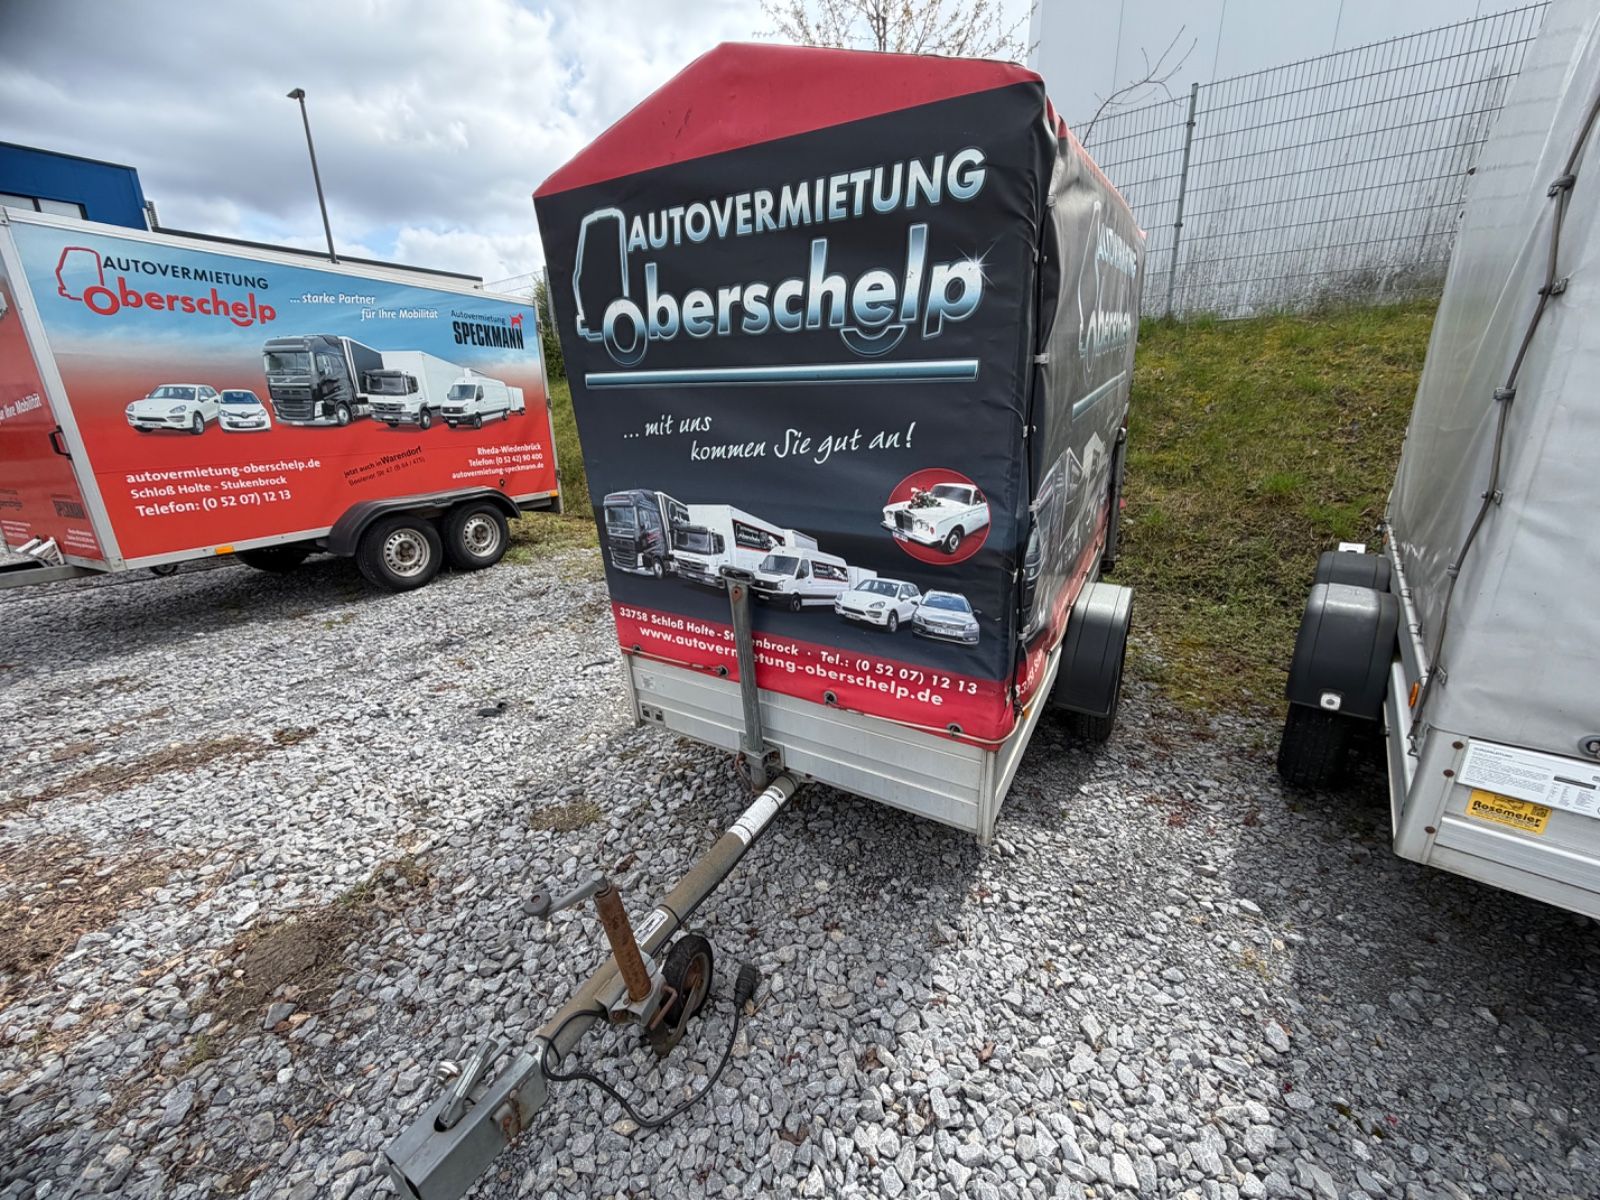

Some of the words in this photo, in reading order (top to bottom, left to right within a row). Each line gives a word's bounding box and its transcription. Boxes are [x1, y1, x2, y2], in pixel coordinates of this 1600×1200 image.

[627, 147, 987, 252] AUTOVERMIETUNG
[103, 255, 269, 289] AUTOVERMIETUNG
[83, 276, 276, 326] Oberschelp
[302, 293, 335, 304] starke
[338, 294, 376, 305] Partner
[603, 224, 984, 364] Oberschelp
[361, 308, 375, 322] für
[378, 308, 396, 319] Ihre
[400, 308, 438, 319] Mobilität
[451, 310, 506, 325] Autovermietung
[452, 320, 524, 350] SPECKMANN
[645, 414, 672, 436] mit
[679, 415, 712, 434] uns
[380, 445, 422, 465] Warendorf
[477, 443, 541, 455] Rheda-Wiedenbrück
[690, 440, 766, 461] kommen
[774, 428, 810, 458] Sie
[814, 428, 862, 464] gut
[868, 422, 916, 450] an!
[125, 458, 321, 484] autovermietung-oberschelp.de
[452, 462, 544, 479] autovermietung-speckmann.de
[468, 458, 495, 467] Telefon:
[130, 486, 176, 499] Schloß
[178, 483, 212, 495] Holte
[220, 475, 288, 491] Stukenbrock
[135, 501, 201, 517] Telefon:
[202, 497, 218, 511] (0
[221, 496, 238, 508] 52
[239, 492, 261, 506] 07)
[263, 491, 277, 502] 12
[278, 489, 292, 500] 13
[619, 606, 648, 622] 33758
[651, 614, 684, 631] Schloß
[686, 622, 715, 637] Holte
[724, 630, 799, 656] Stnbrock
[821, 651, 849, 667] Tel.:
[856, 659, 870, 671] (0
[875, 664, 894, 676] 52
[899, 669, 924, 685] 07)
[932, 676, 950, 689] 12
[959, 681, 978, 694] 13
[640, 626, 943, 706] www.autovertung-oberschelp.de
[1473, 800, 1542, 823] Rosemeier
